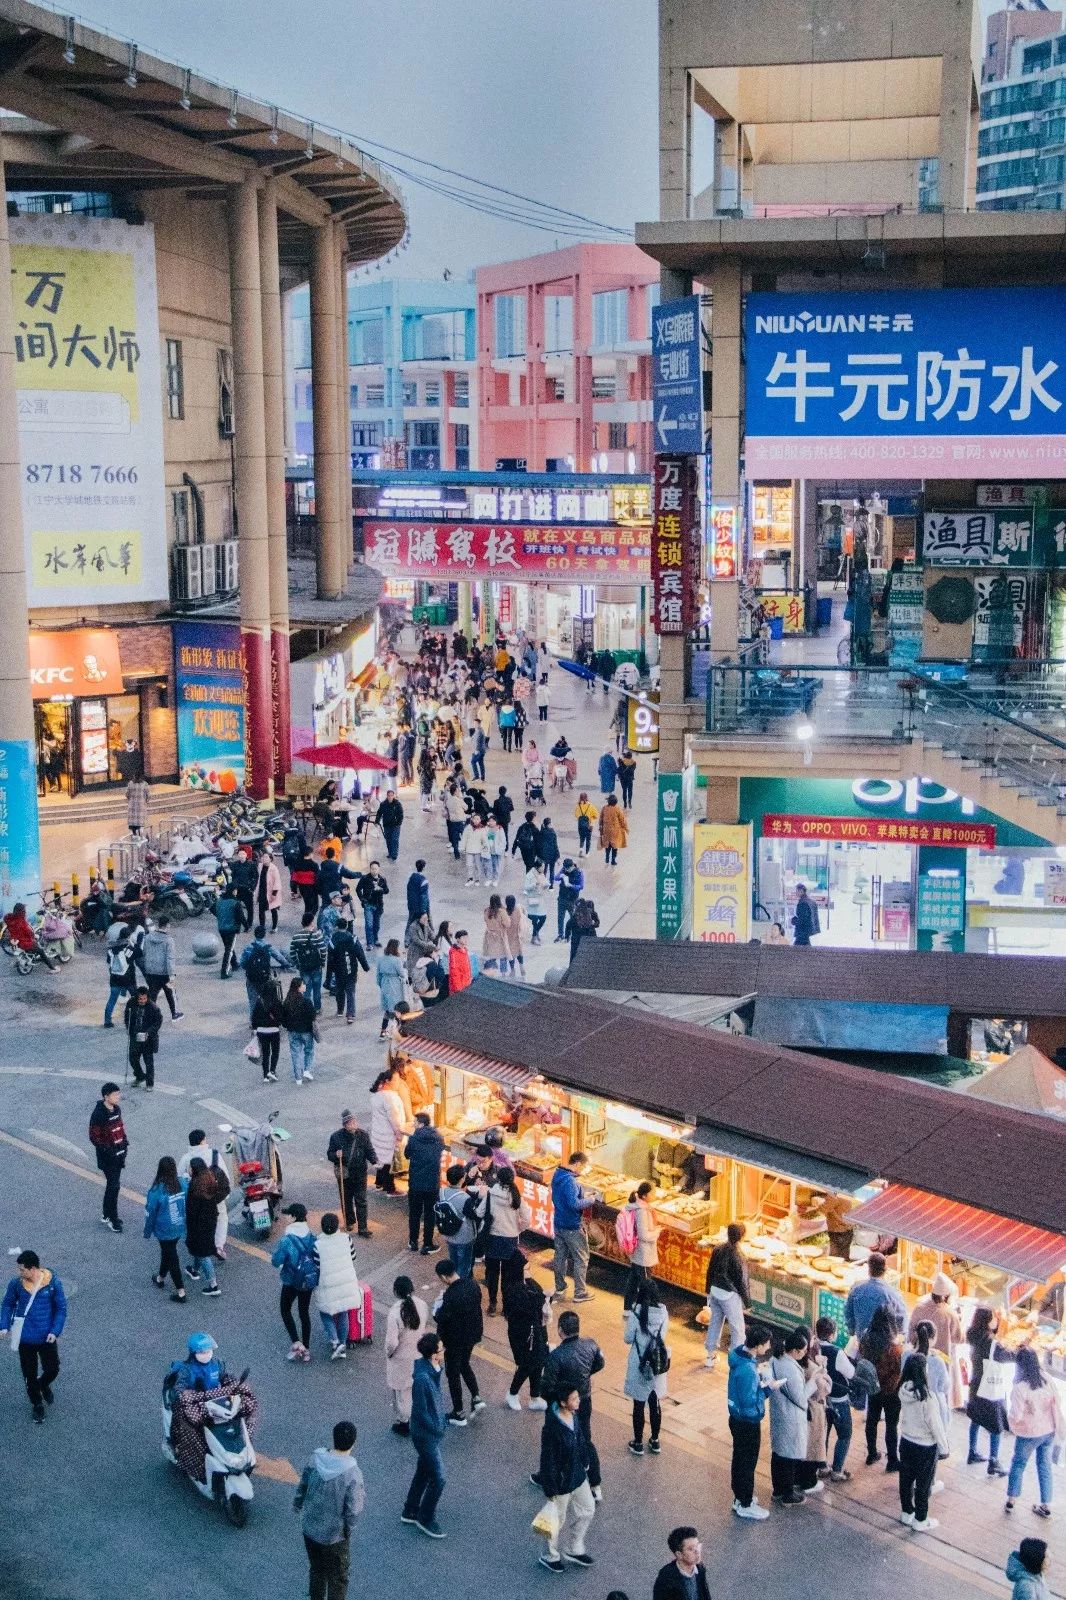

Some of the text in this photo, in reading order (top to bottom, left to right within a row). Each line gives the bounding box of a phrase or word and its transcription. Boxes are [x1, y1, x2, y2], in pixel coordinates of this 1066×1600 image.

[15, 322, 140, 374] 间大师
[765, 346, 1063, 424] 牛元防水
[26, 464, 138, 484] 8718 7666
[657, 461, 684, 622] 万度连锁宾馆
[926, 516, 991, 555] 渔具
[30, 667, 74, 684] KFC
[662, 816, 679, 901] 一杯水果
